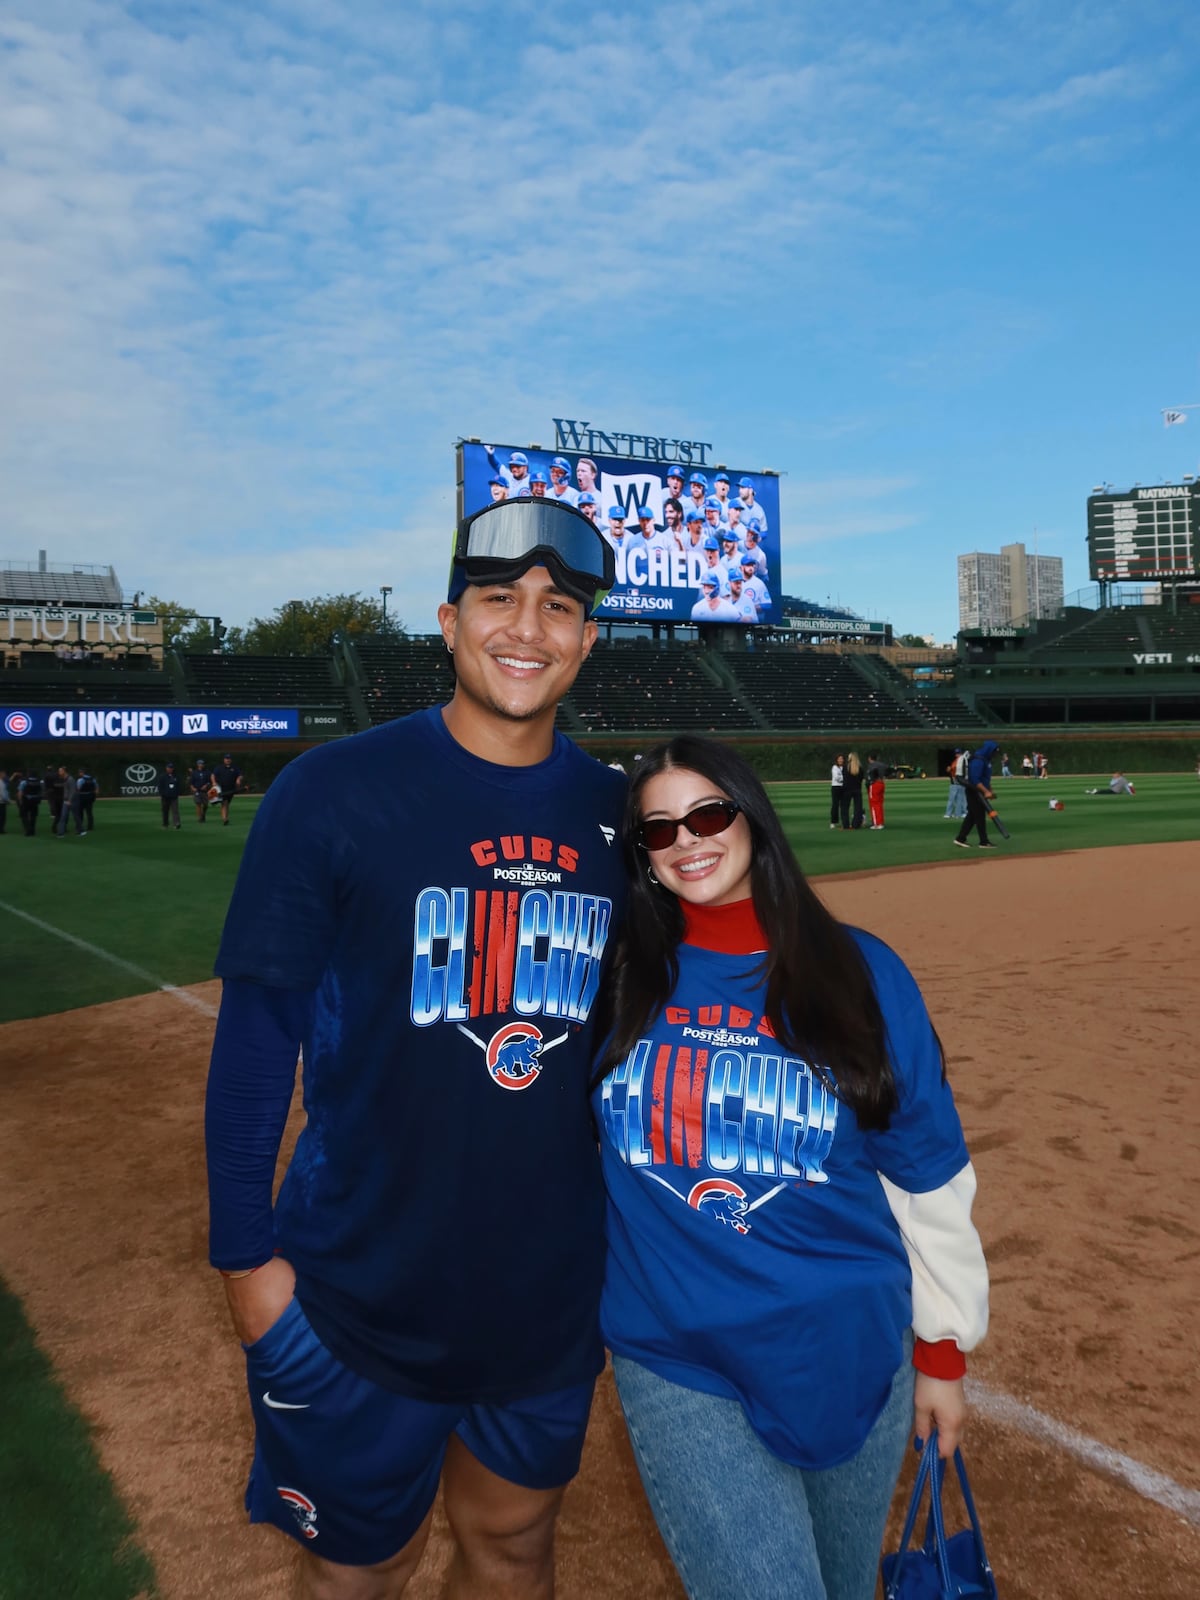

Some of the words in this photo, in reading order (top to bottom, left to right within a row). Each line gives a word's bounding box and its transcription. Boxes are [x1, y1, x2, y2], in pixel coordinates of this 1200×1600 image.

[552, 418, 713, 465] WINTRUST
[613, 482, 651, 519] W
[1138, 486, 1192, 499] NATIONAL
[614, 547, 705, 588] NCHED
[602, 595, 673, 610] OSTSEASON
[990, 627, 1017, 637] Mobile
[1133, 653, 1172, 664] YETI
[48, 711, 170, 737] CLINCHED
[188, 717, 203, 731] W
[221, 719, 288, 730] POSTSEASON
[120, 786, 159, 795] TOYOTA
[470, 835, 579, 873] CUBS
[493, 867, 562, 883] POSTSEASON
[410, 886, 613, 1027] CLINCHED
[682, 1026, 760, 1046] POSTSEASON
